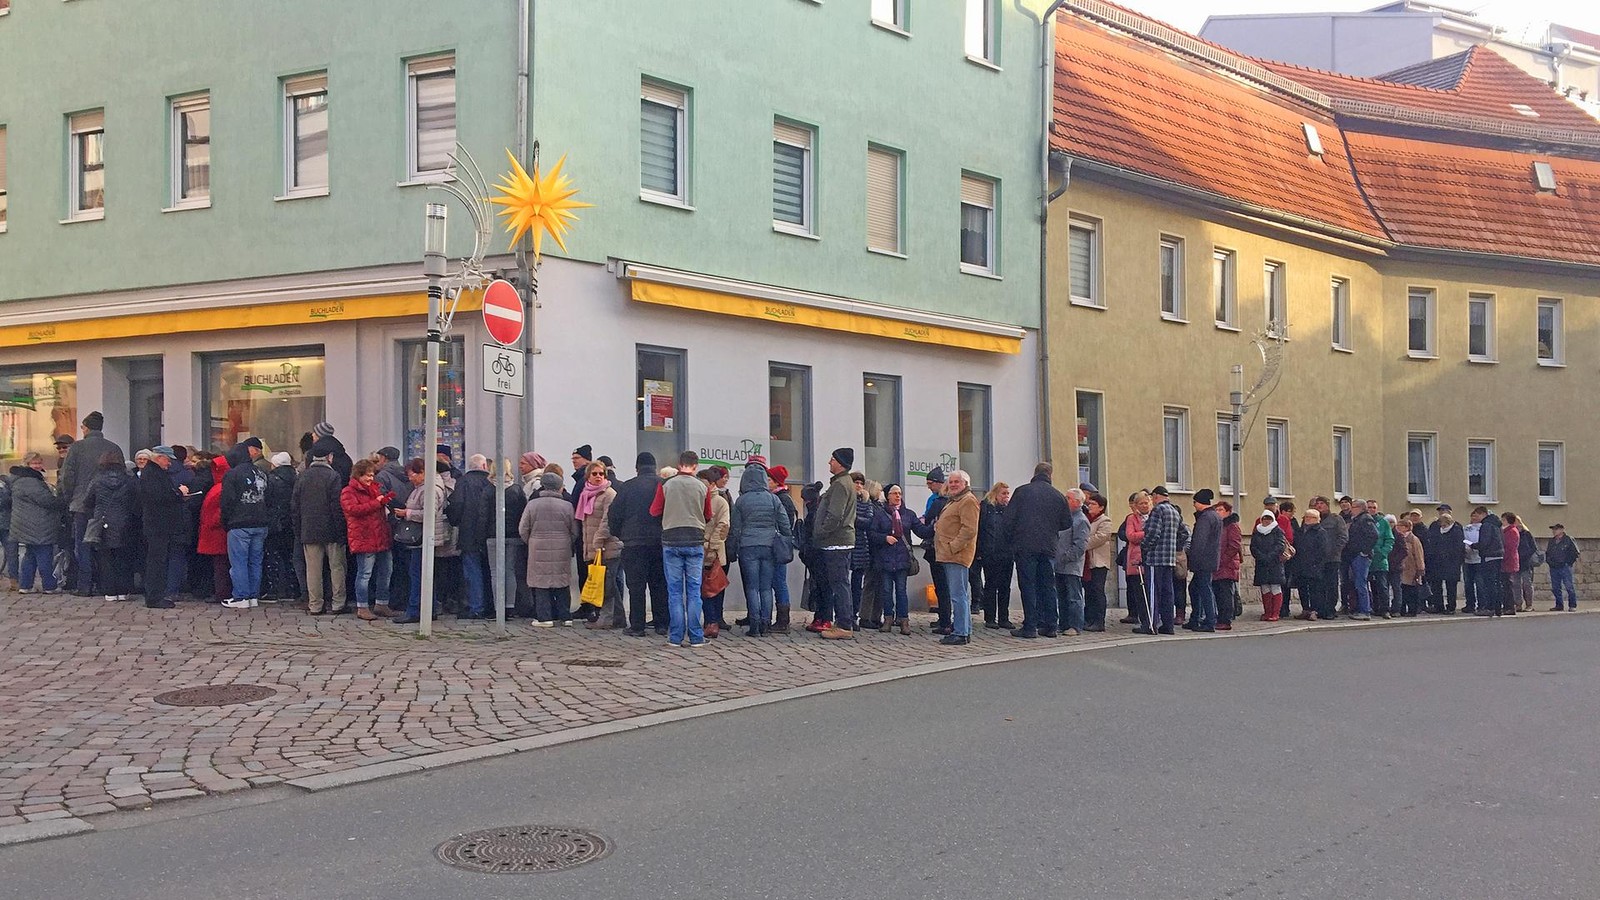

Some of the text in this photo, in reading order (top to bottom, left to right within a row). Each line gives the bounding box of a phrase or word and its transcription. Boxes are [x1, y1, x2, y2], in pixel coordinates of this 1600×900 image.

[310, 303, 344, 315] BUCHLADEN
[765, 306, 795, 317] BUCHLADEN
[244, 373, 299, 385] BUCHLADEN
[497, 377, 511, 390] frei
[700, 447, 752, 461] BUCHLAD
